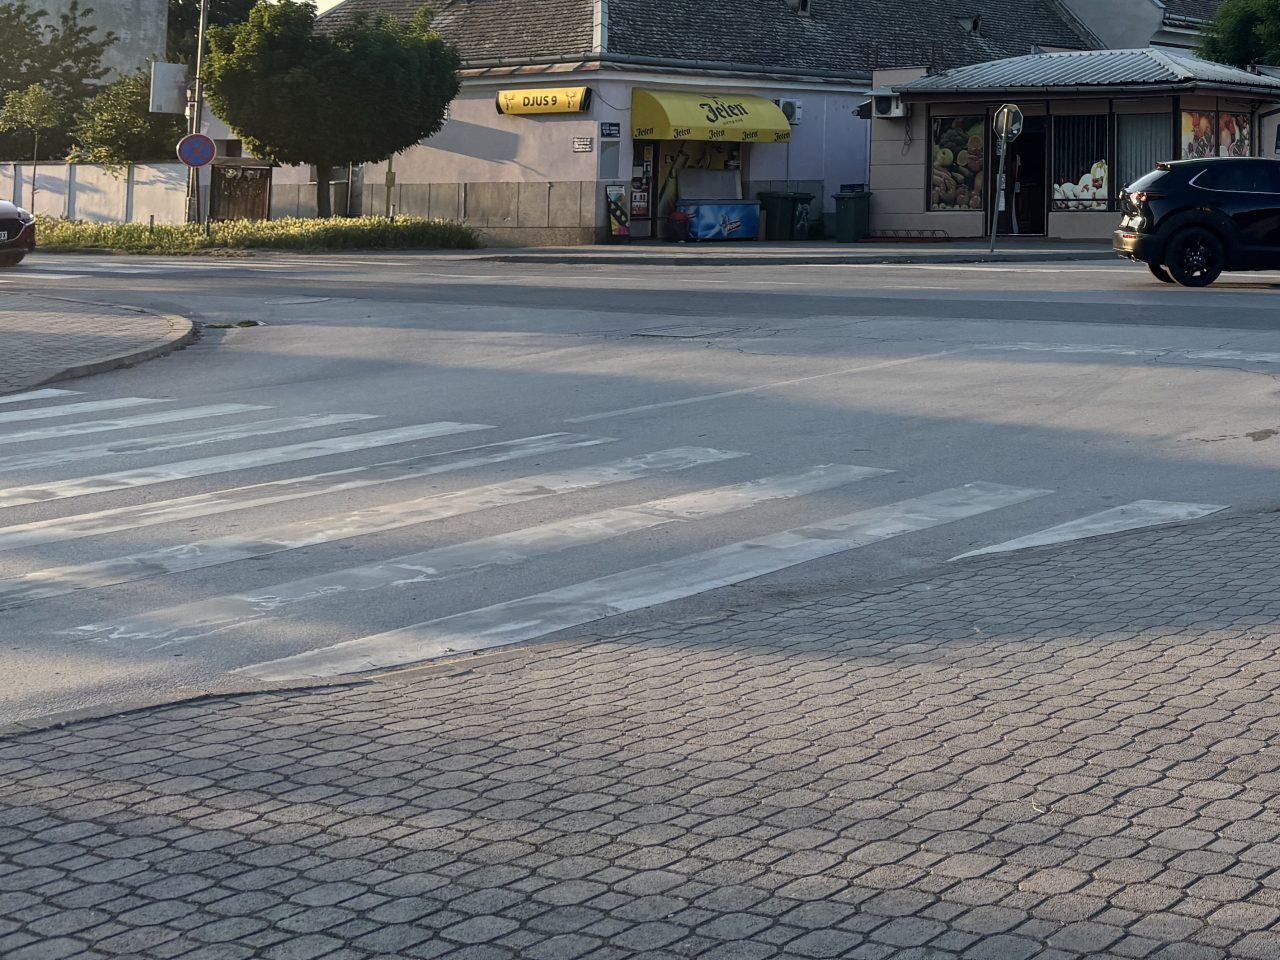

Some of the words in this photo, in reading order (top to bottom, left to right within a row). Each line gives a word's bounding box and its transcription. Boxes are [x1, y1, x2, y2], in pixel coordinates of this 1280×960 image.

[522, 96, 549, 107] DJUS
[551, 96, 558, 105] 9
[699, 102, 749, 123] Jelen
[634, 127, 654, 137] Jelen
[673, 128, 691, 138] Jelen
[708, 129, 725, 139] Jelen
[742, 130, 758, 140] Jelen
